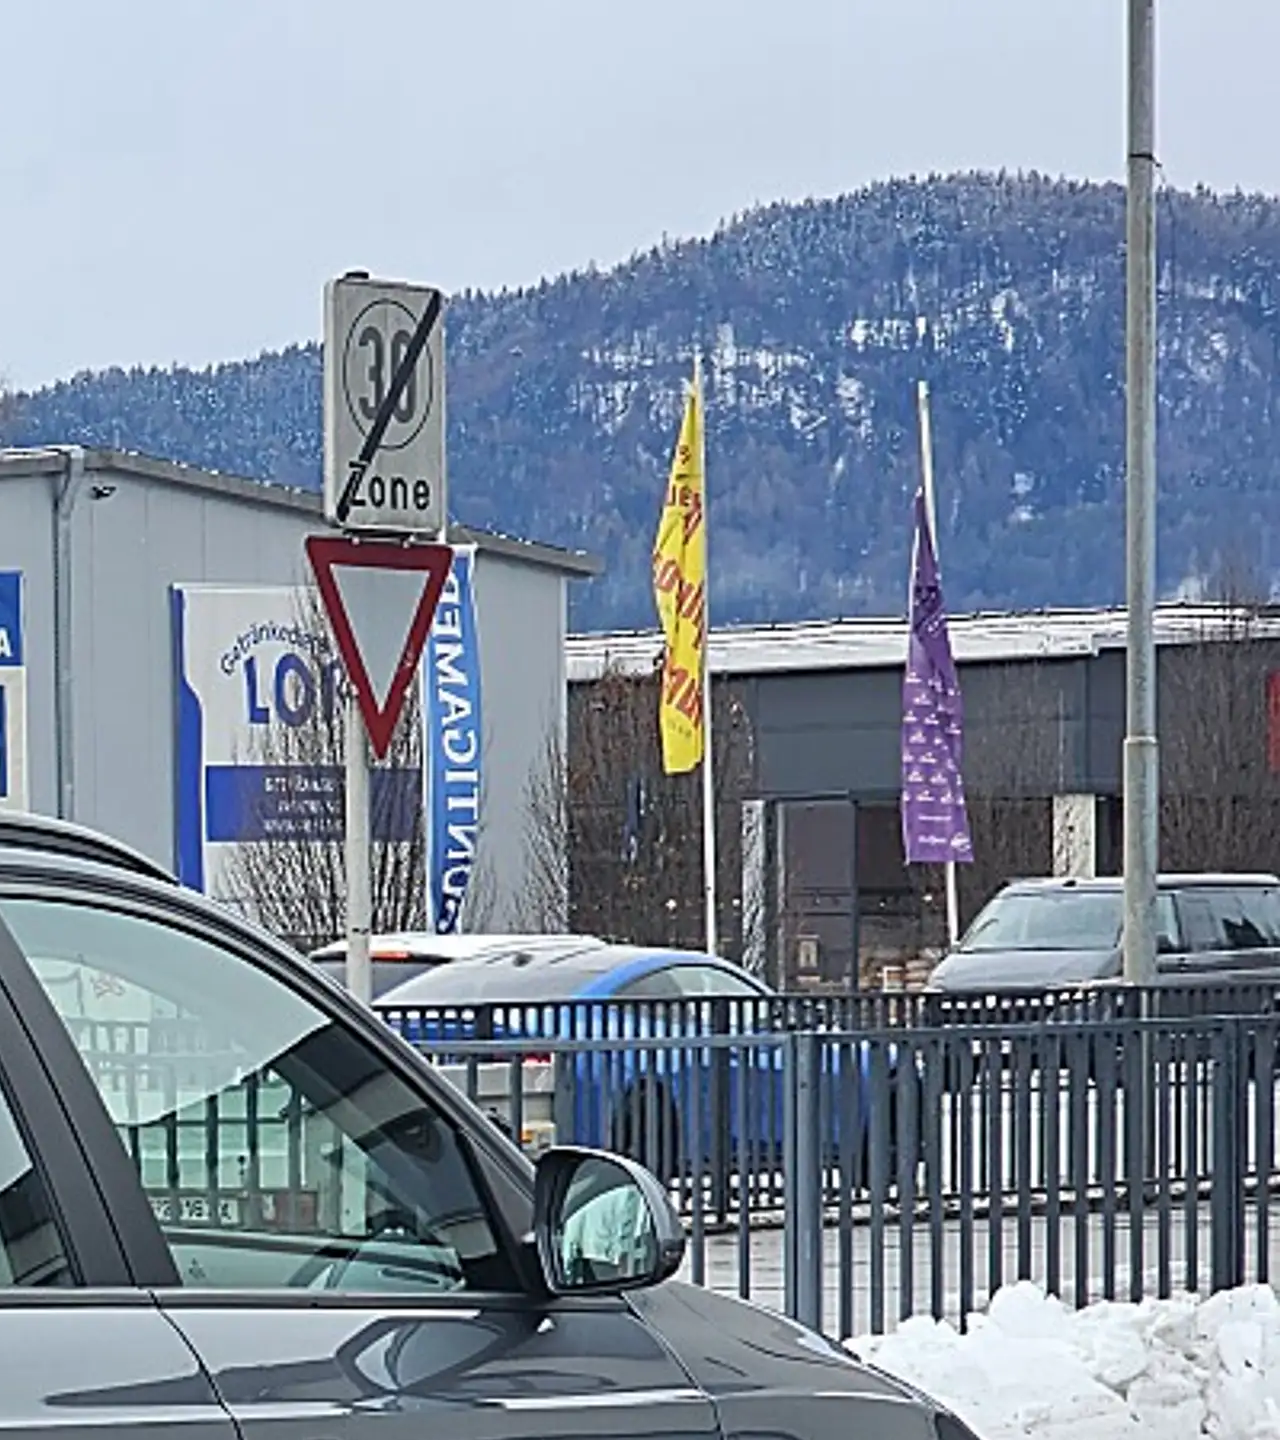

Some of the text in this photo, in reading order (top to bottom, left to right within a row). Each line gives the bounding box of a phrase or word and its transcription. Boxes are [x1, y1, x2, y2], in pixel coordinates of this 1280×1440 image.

[357, 325, 418, 425] 30
[347, 461, 431, 511] Zone
[244, 653, 344, 727] LO
